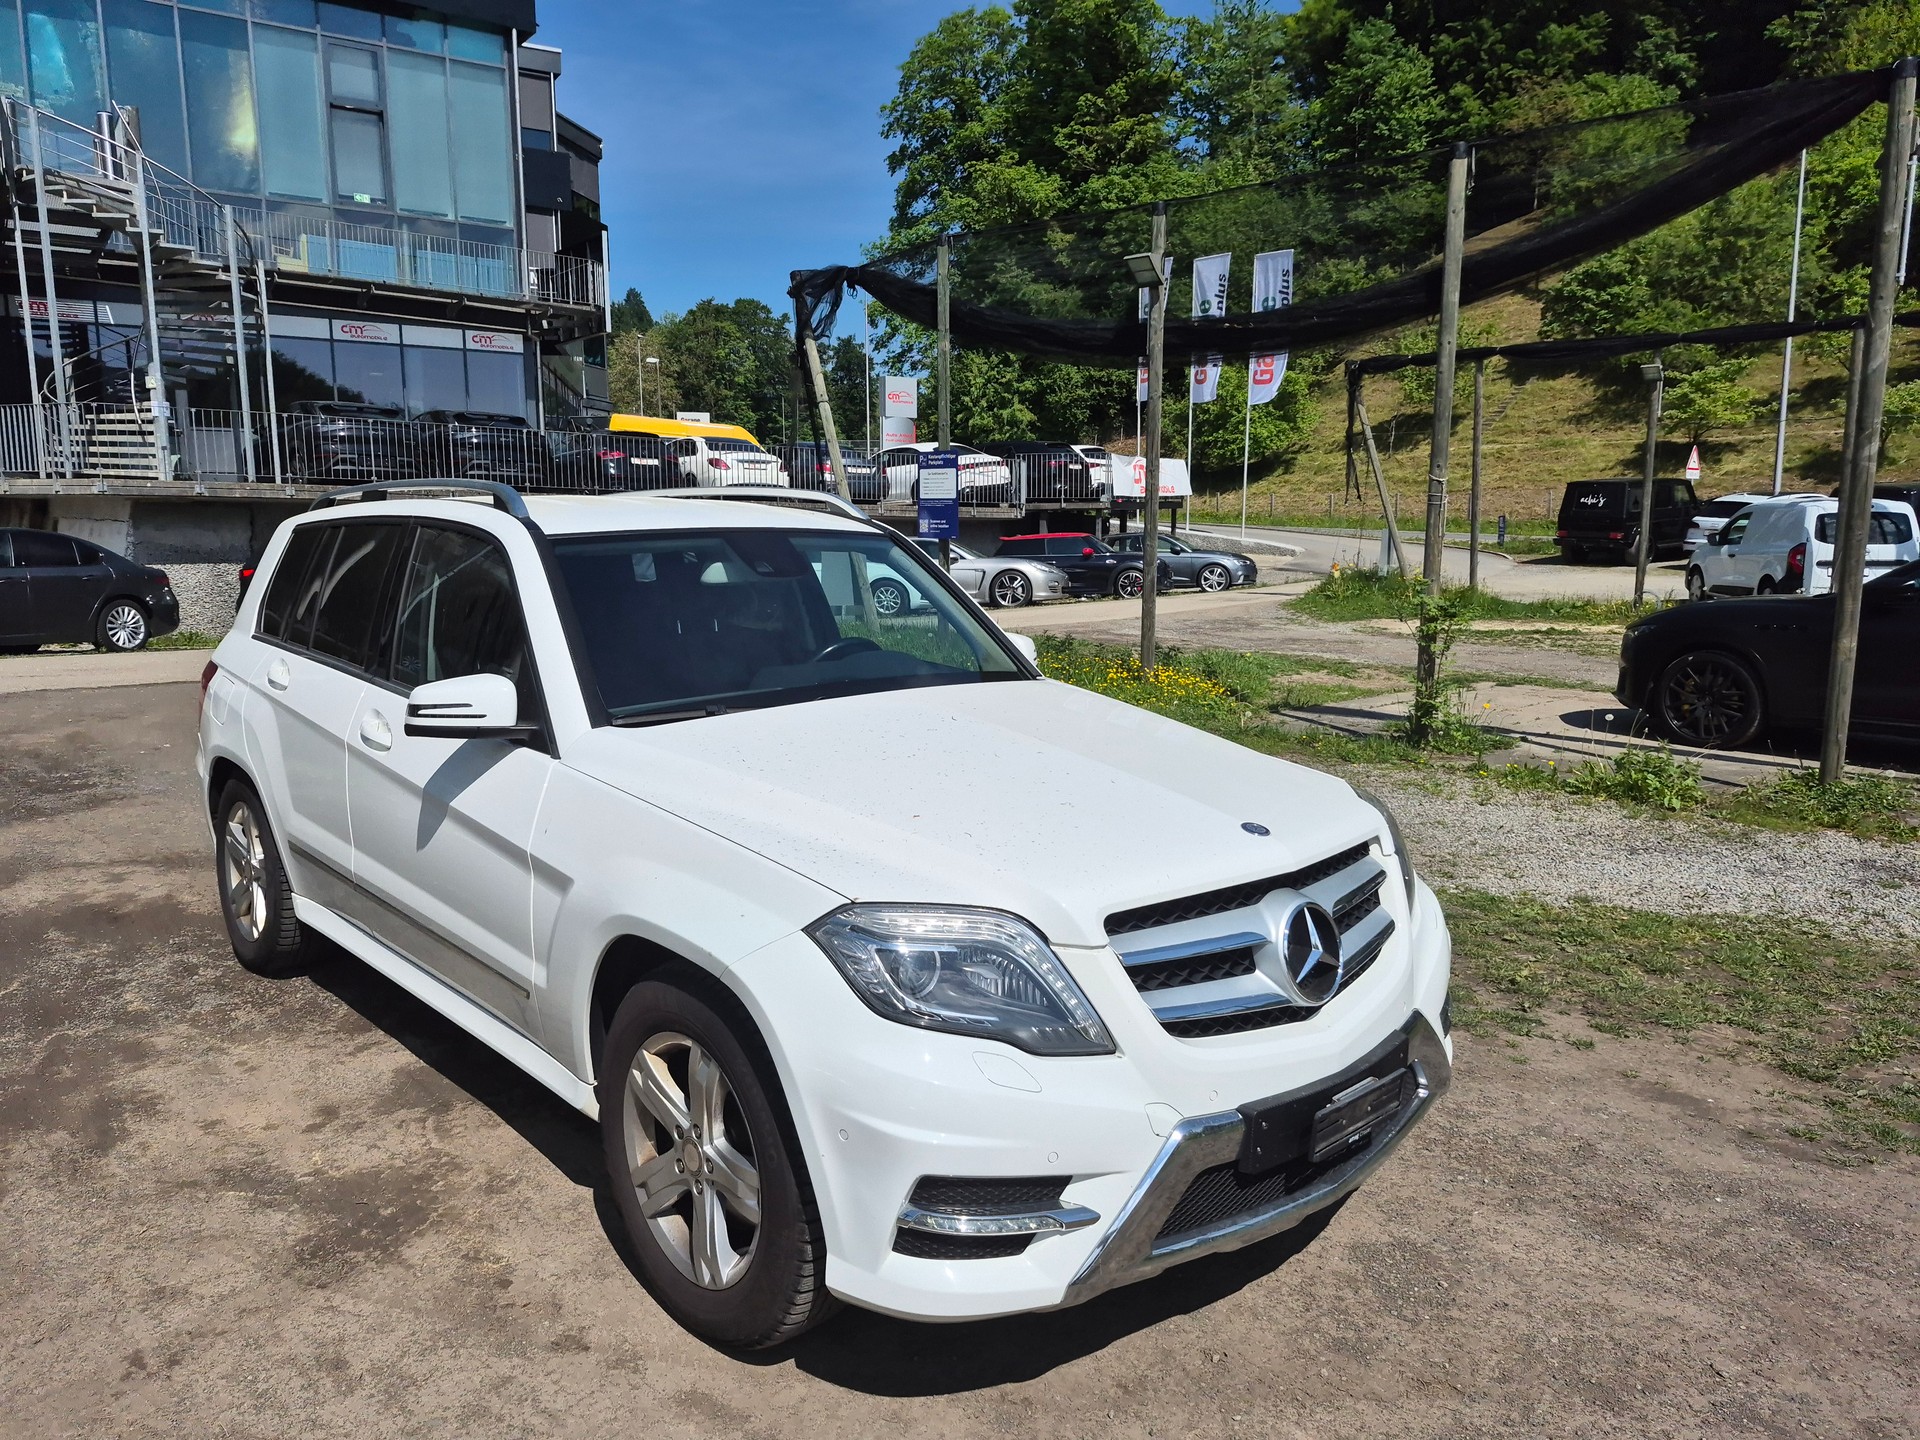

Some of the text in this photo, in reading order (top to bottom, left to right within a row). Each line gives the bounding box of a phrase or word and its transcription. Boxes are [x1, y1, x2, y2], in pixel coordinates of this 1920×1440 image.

[340, 324, 365, 335] cm
[471, 334, 494, 345] cm
[887, 393, 900, 401] cm
